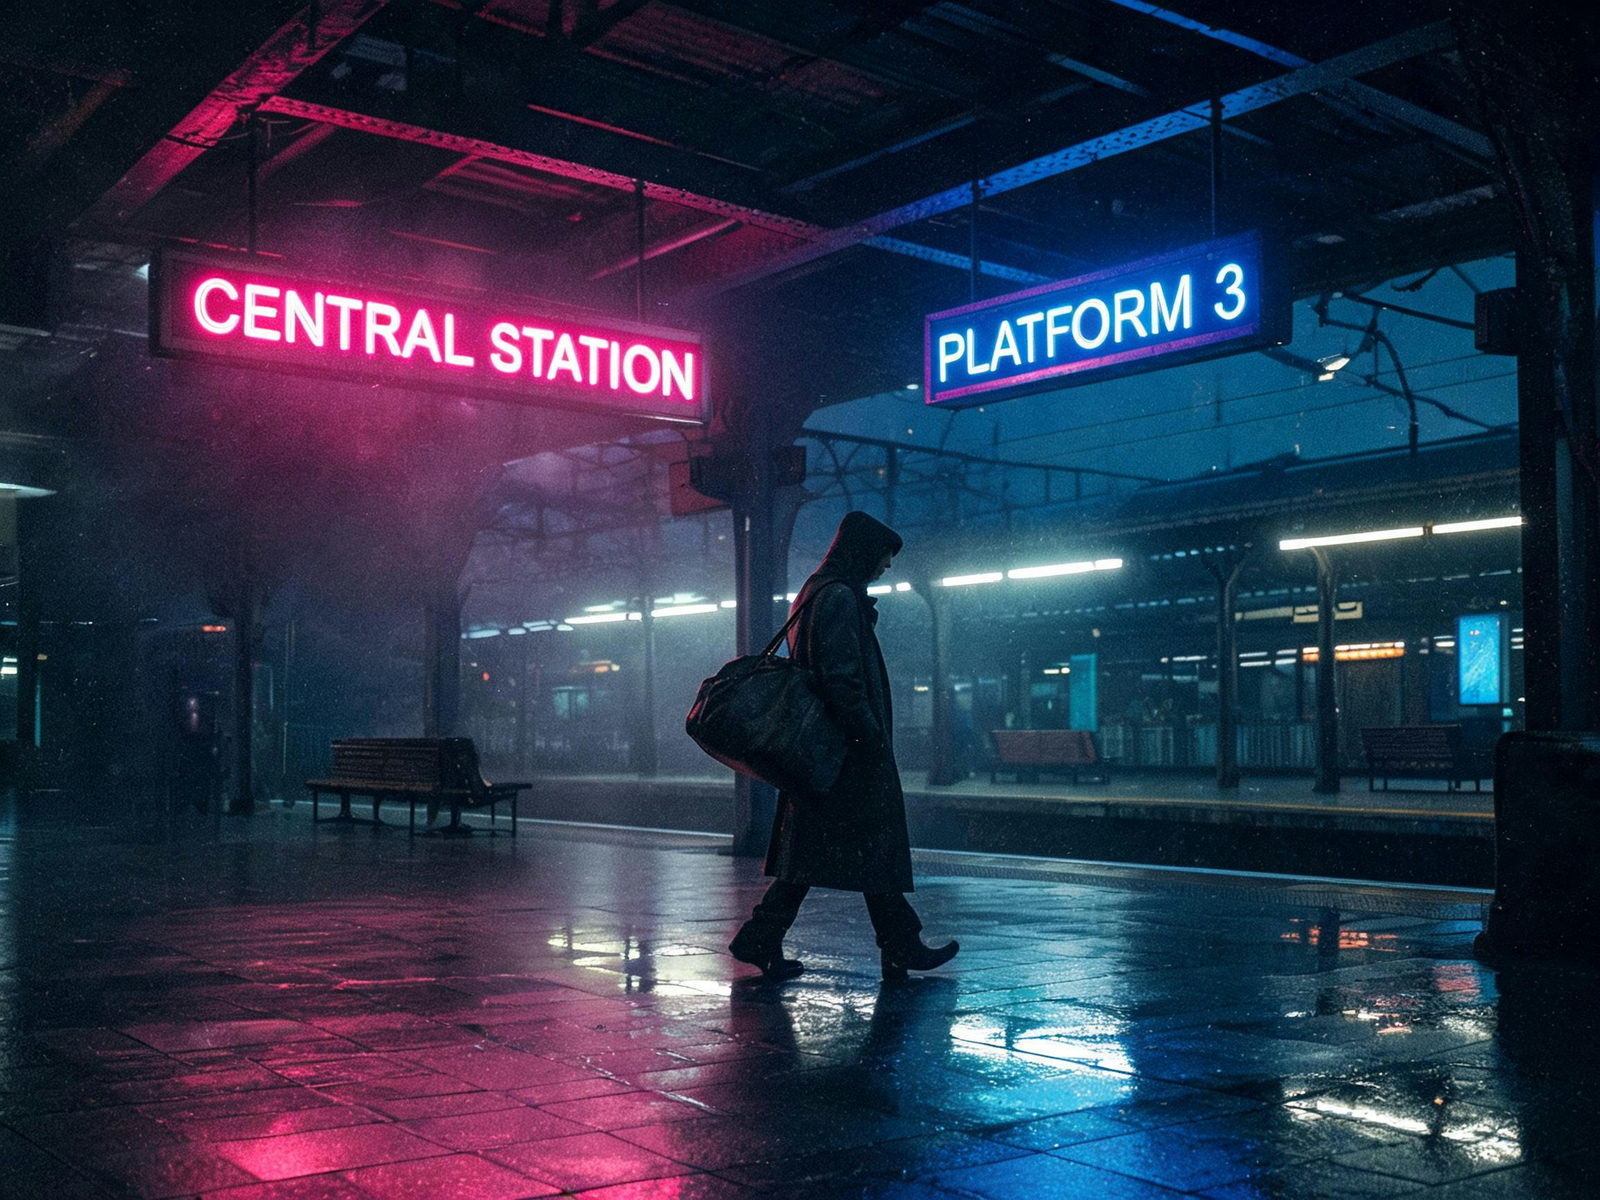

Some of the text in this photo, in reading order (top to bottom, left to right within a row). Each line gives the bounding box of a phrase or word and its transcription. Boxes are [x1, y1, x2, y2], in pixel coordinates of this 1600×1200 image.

[194, 278, 694, 400] CENTRAL STATION
[938, 262, 1248, 383] PLATFORM 3
